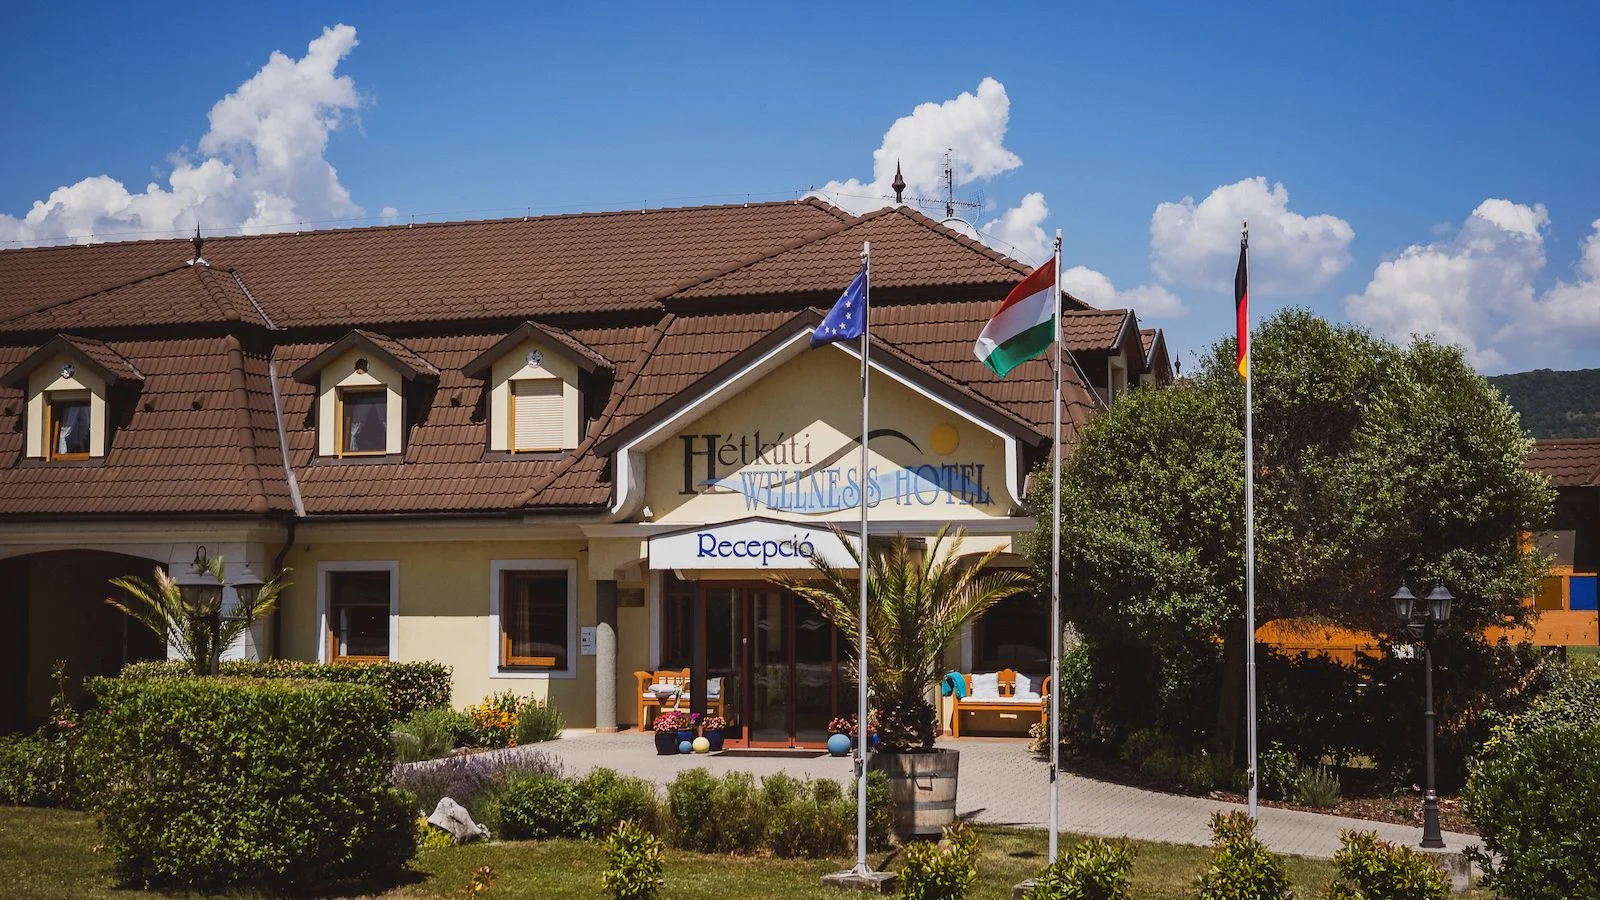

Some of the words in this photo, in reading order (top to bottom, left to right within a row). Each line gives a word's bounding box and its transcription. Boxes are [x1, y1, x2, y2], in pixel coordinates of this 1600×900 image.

[678, 430, 812, 495] Hétkúti
[739, 465, 882, 514] WELLNESS
[896, 461, 991, 507] HOTEL
[696, 533, 815, 566] Recepció
